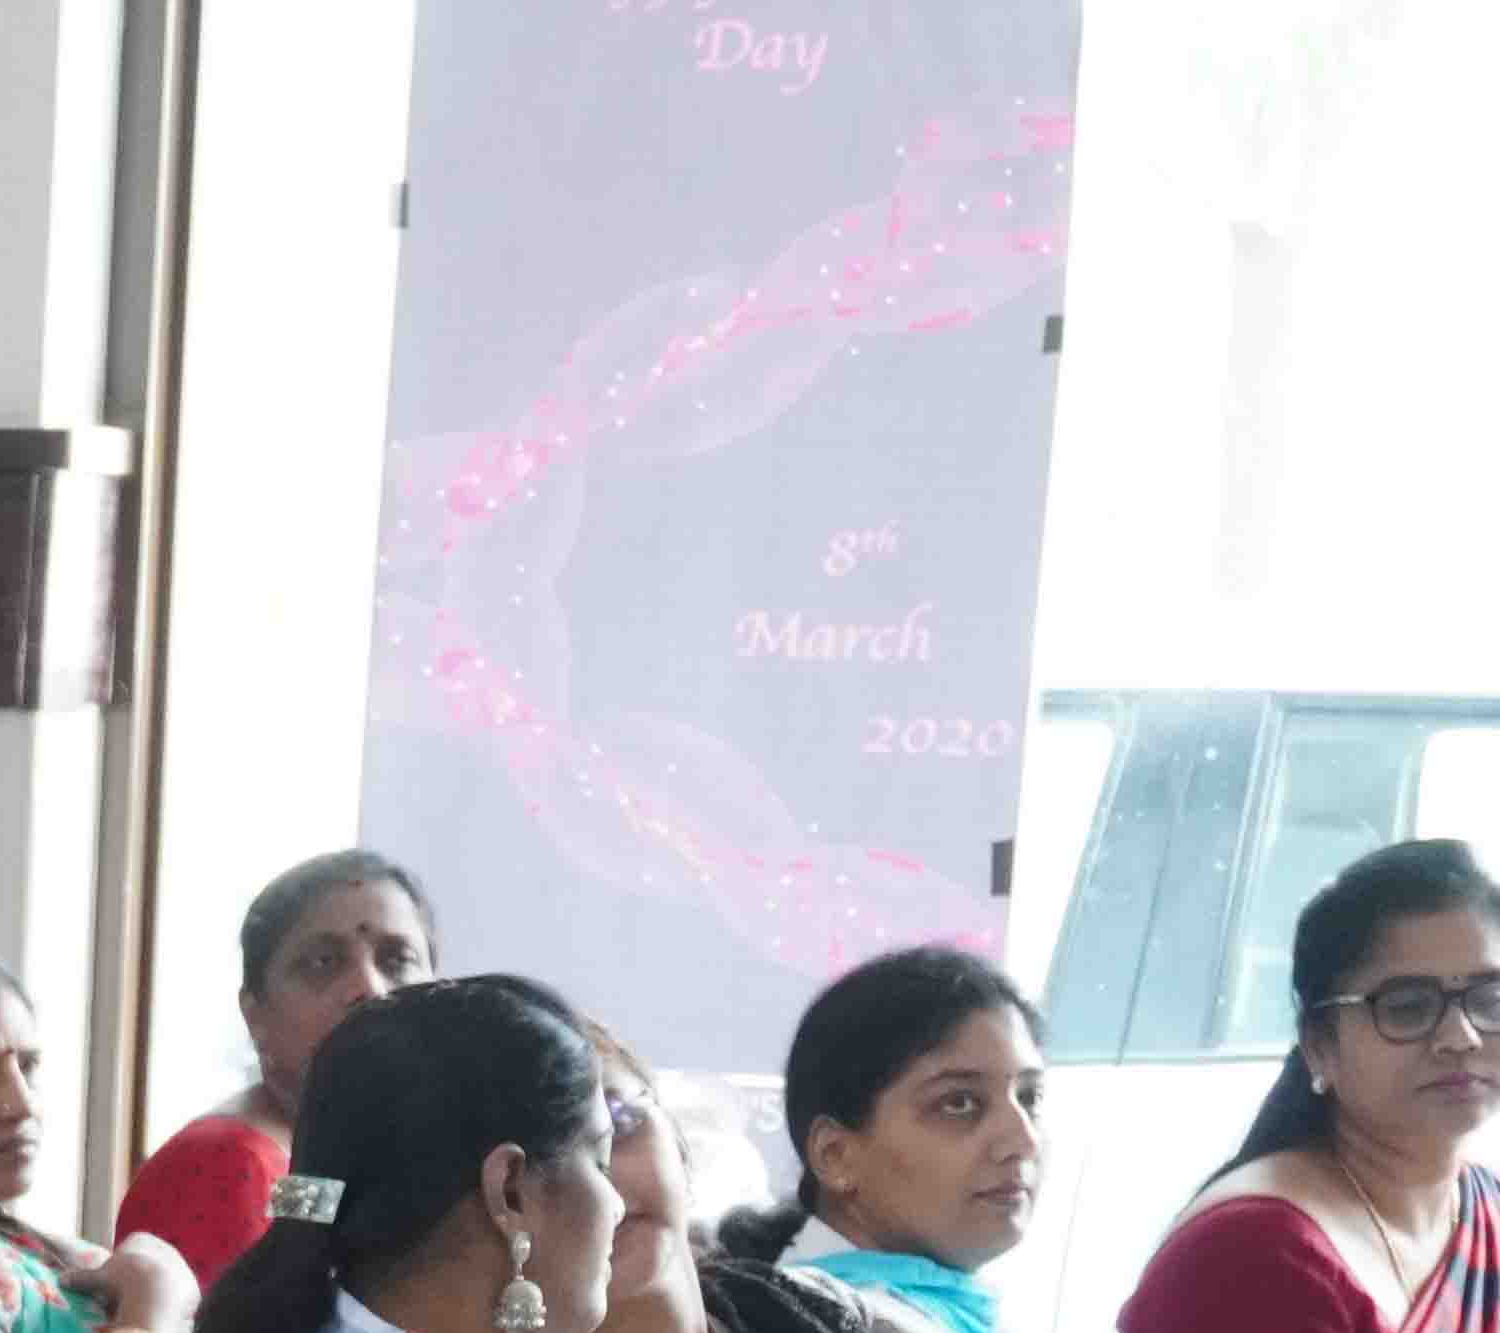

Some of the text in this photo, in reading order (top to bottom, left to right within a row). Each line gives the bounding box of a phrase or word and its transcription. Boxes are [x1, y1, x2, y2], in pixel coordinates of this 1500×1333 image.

[694, 18, 828, 95] Day
[822, 519, 902, 577] 8th
[734, 602, 934, 660] March
[860, 718, 1015, 757] 2020
